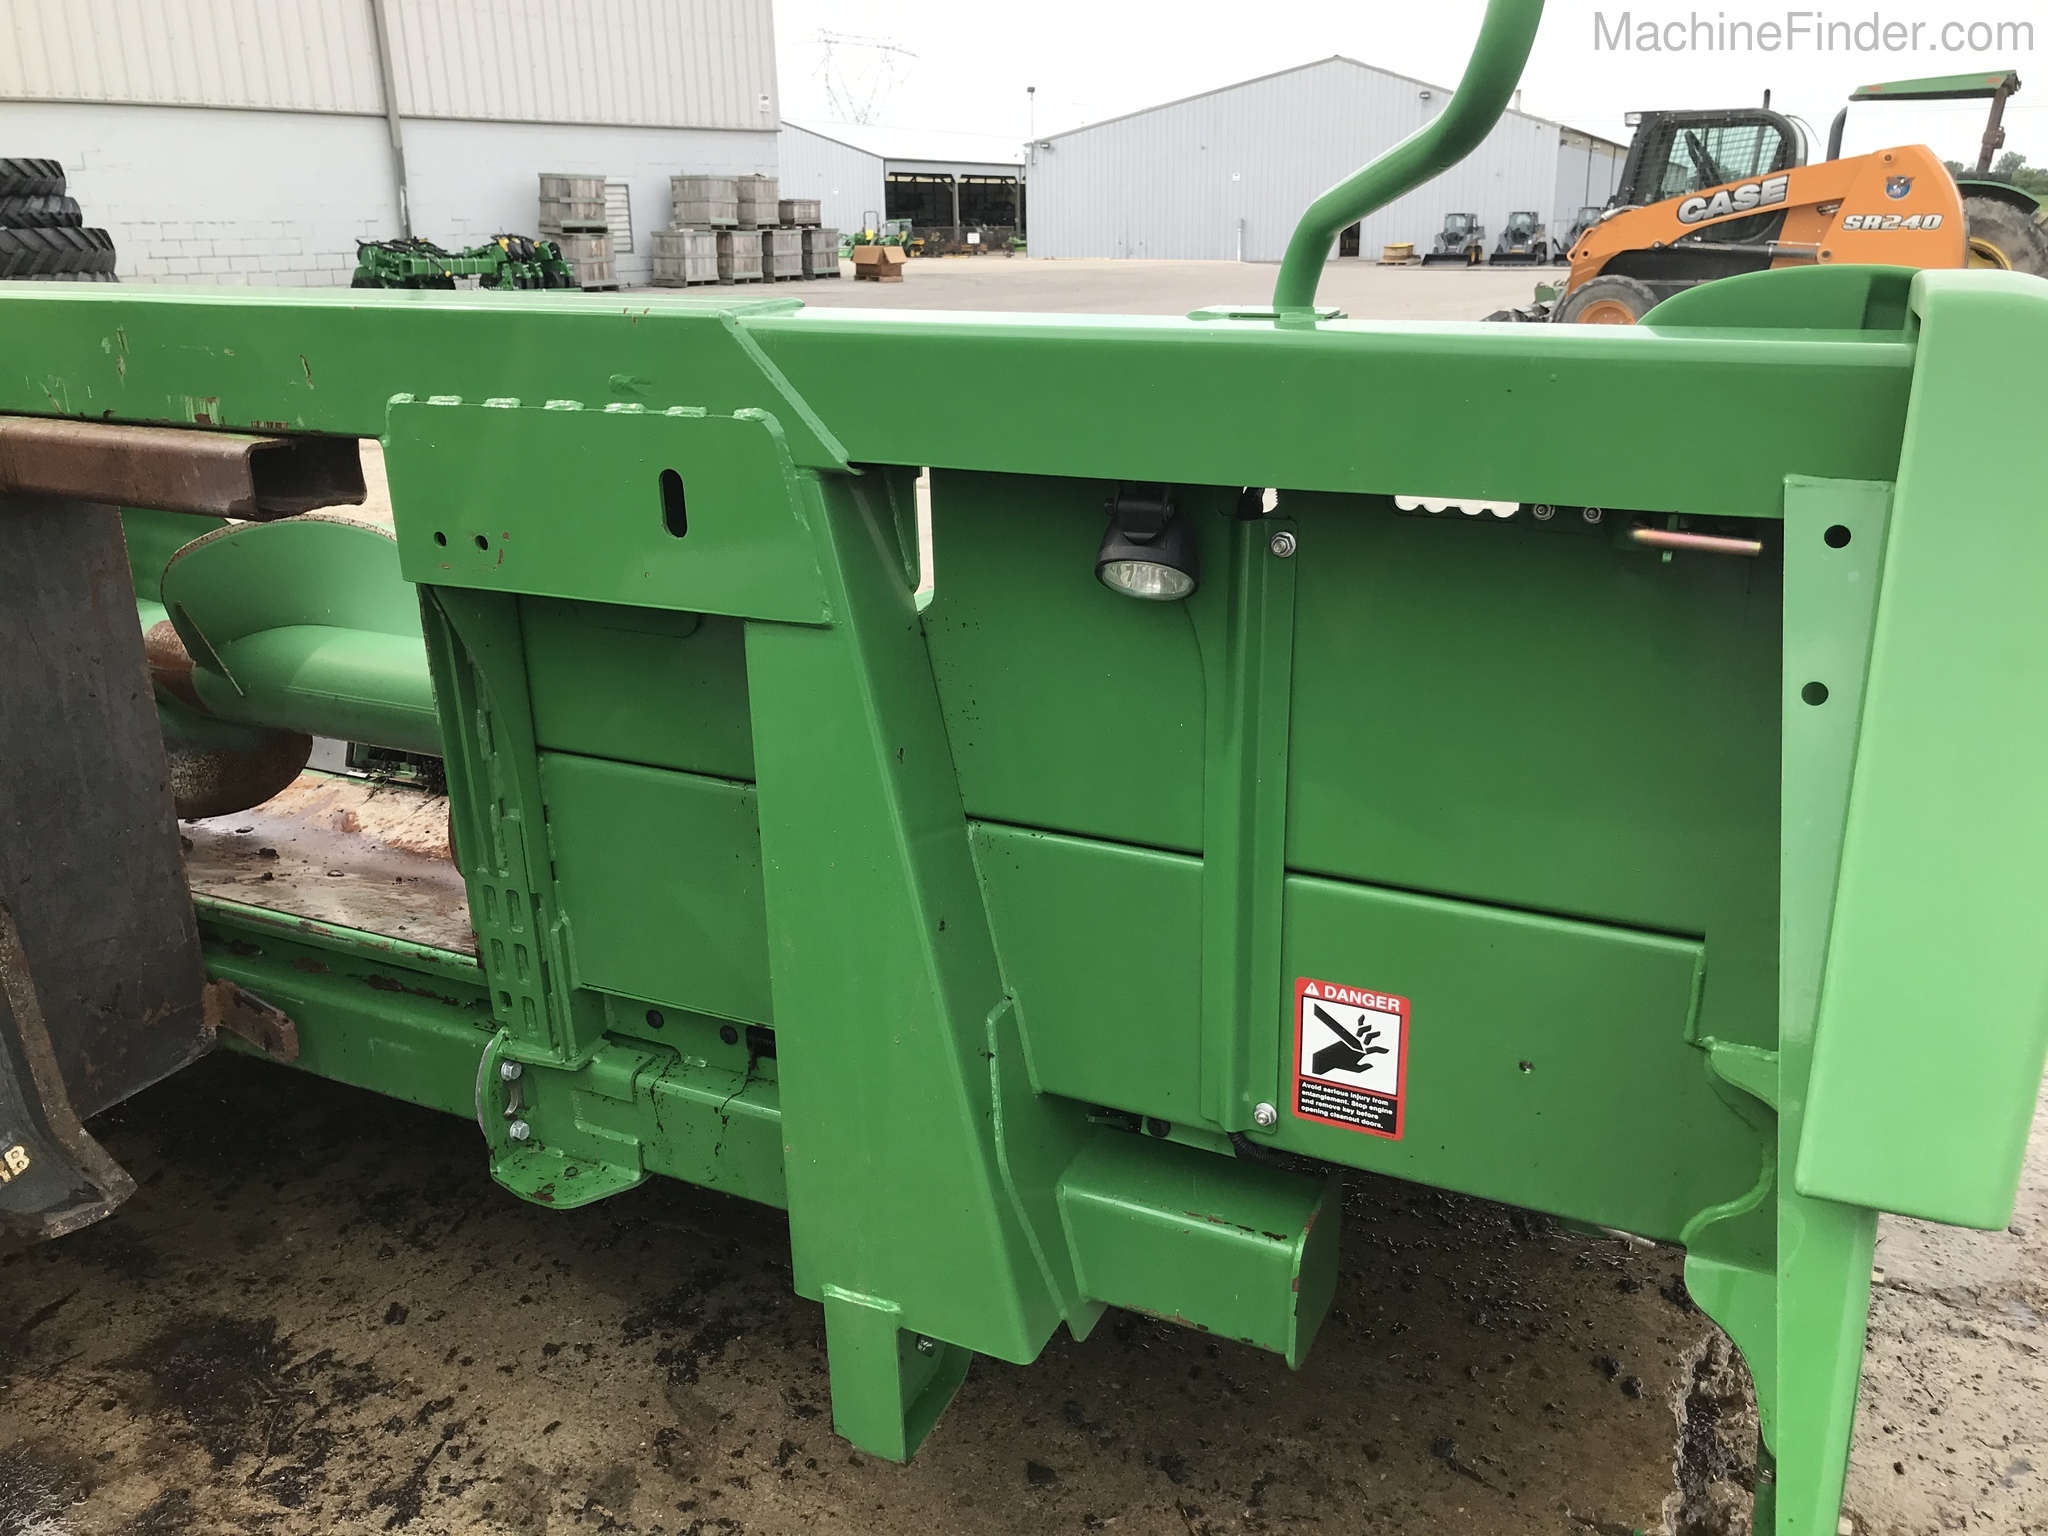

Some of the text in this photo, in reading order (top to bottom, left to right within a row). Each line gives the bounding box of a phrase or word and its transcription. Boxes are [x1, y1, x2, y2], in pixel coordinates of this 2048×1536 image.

[1679, 174, 1789, 224] CASE
[1842, 213, 1944, 231] SR240
[1324, 985, 1400, 1012] DANGER
[1301, 1090, 1393, 1115] entanglement. Stop engine
[1302, 1081, 1389, 1106] Avoid serious injury from
[1301, 1097, 1379, 1120] and remove key before
[1301, 1105, 1384, 1129] opening cleanout doors.
